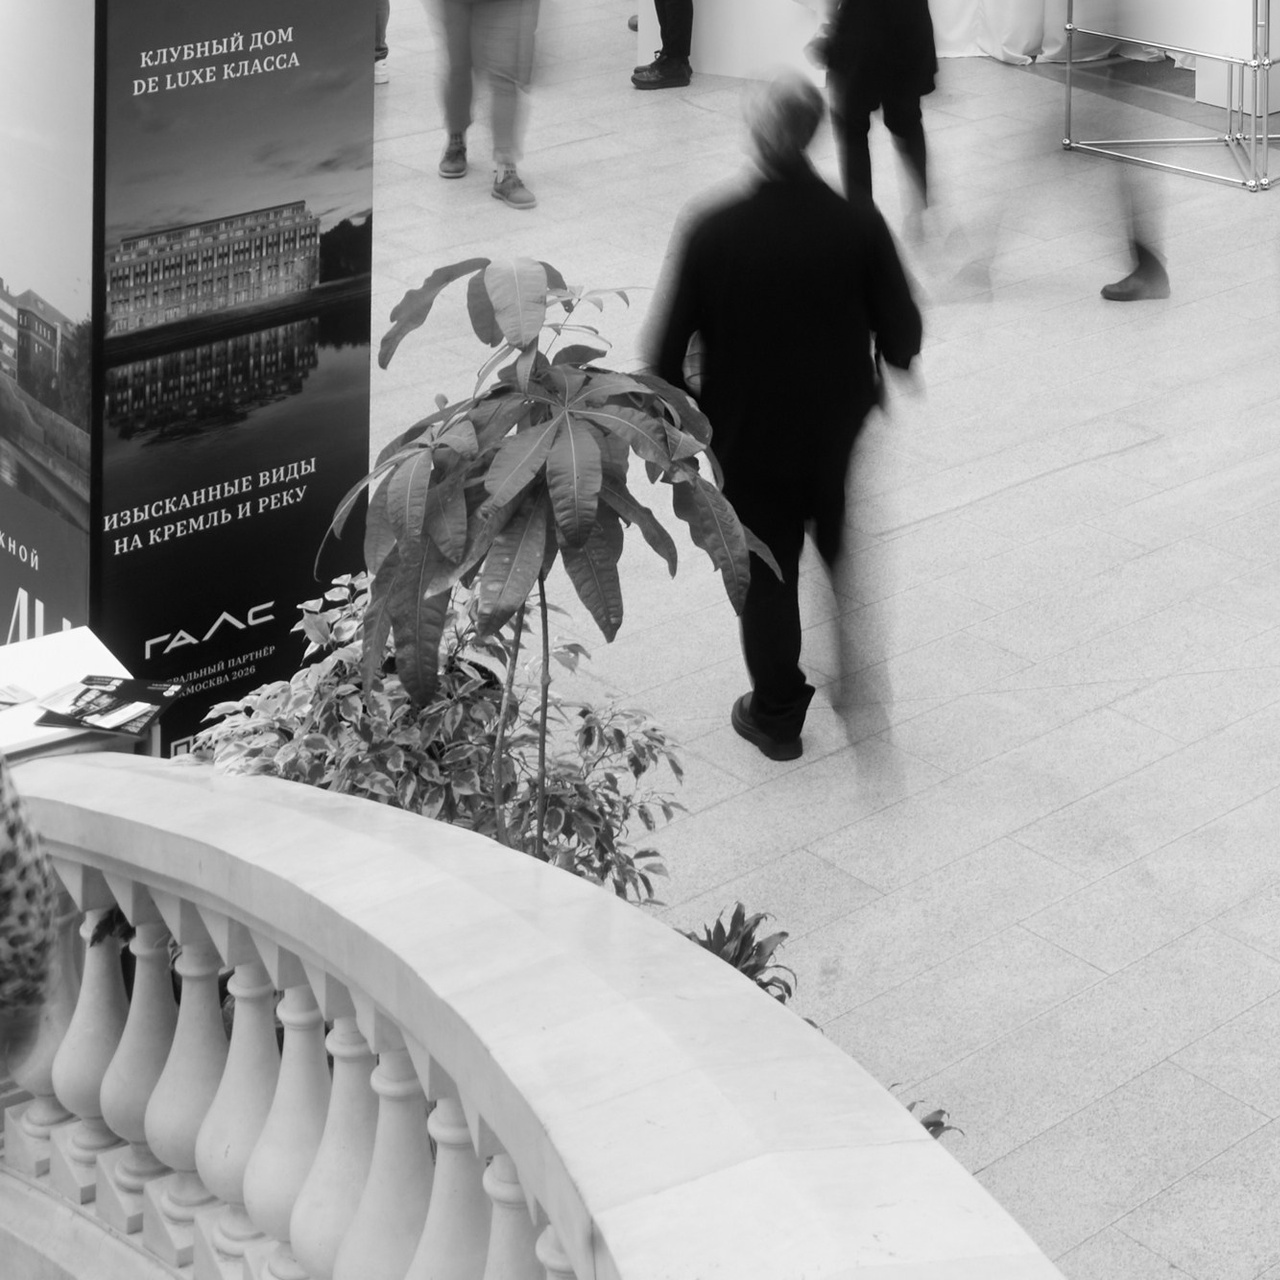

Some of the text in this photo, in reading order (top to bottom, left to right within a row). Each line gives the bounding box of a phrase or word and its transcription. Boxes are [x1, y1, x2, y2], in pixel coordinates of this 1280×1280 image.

[140, 27, 293, 68] КЛУБНЫЙ ДОМ
[132, 52, 300, 96] DE LUXE КЛАССА
[103, 457, 317, 532] ИЗЫСКАННЫЕ ВИДЫ
[114, 486, 307, 555] НА КРЕМЛЬ И РЕКУ
[228, 646, 276, 668] ПАРТНЁР
[231, 665, 256, 681] 2026
